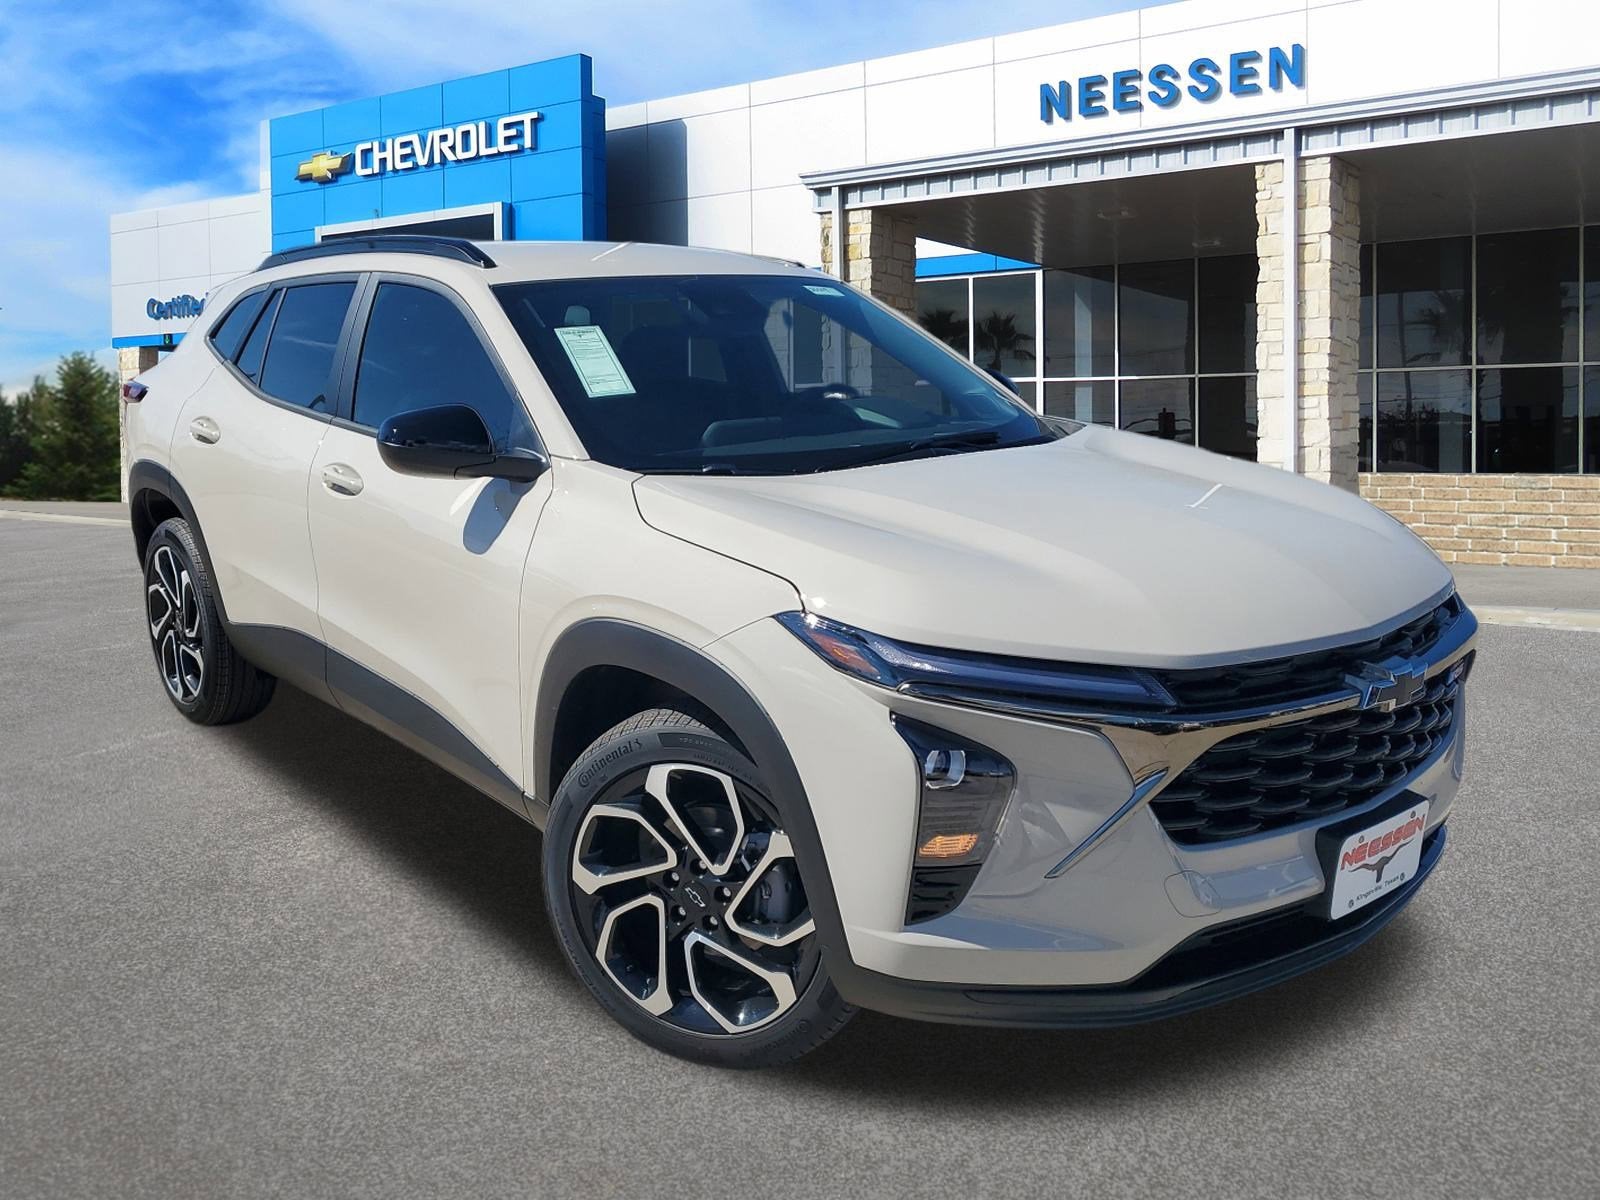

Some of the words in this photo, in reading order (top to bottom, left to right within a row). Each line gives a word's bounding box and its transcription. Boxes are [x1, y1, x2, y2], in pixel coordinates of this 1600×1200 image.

[1040, 44, 1305, 123] NEESSEN
[354, 112, 541, 177] CHEVROLET
[577, 742, 634, 788] Continental
[1340, 813, 1425, 871] NEESSEN
